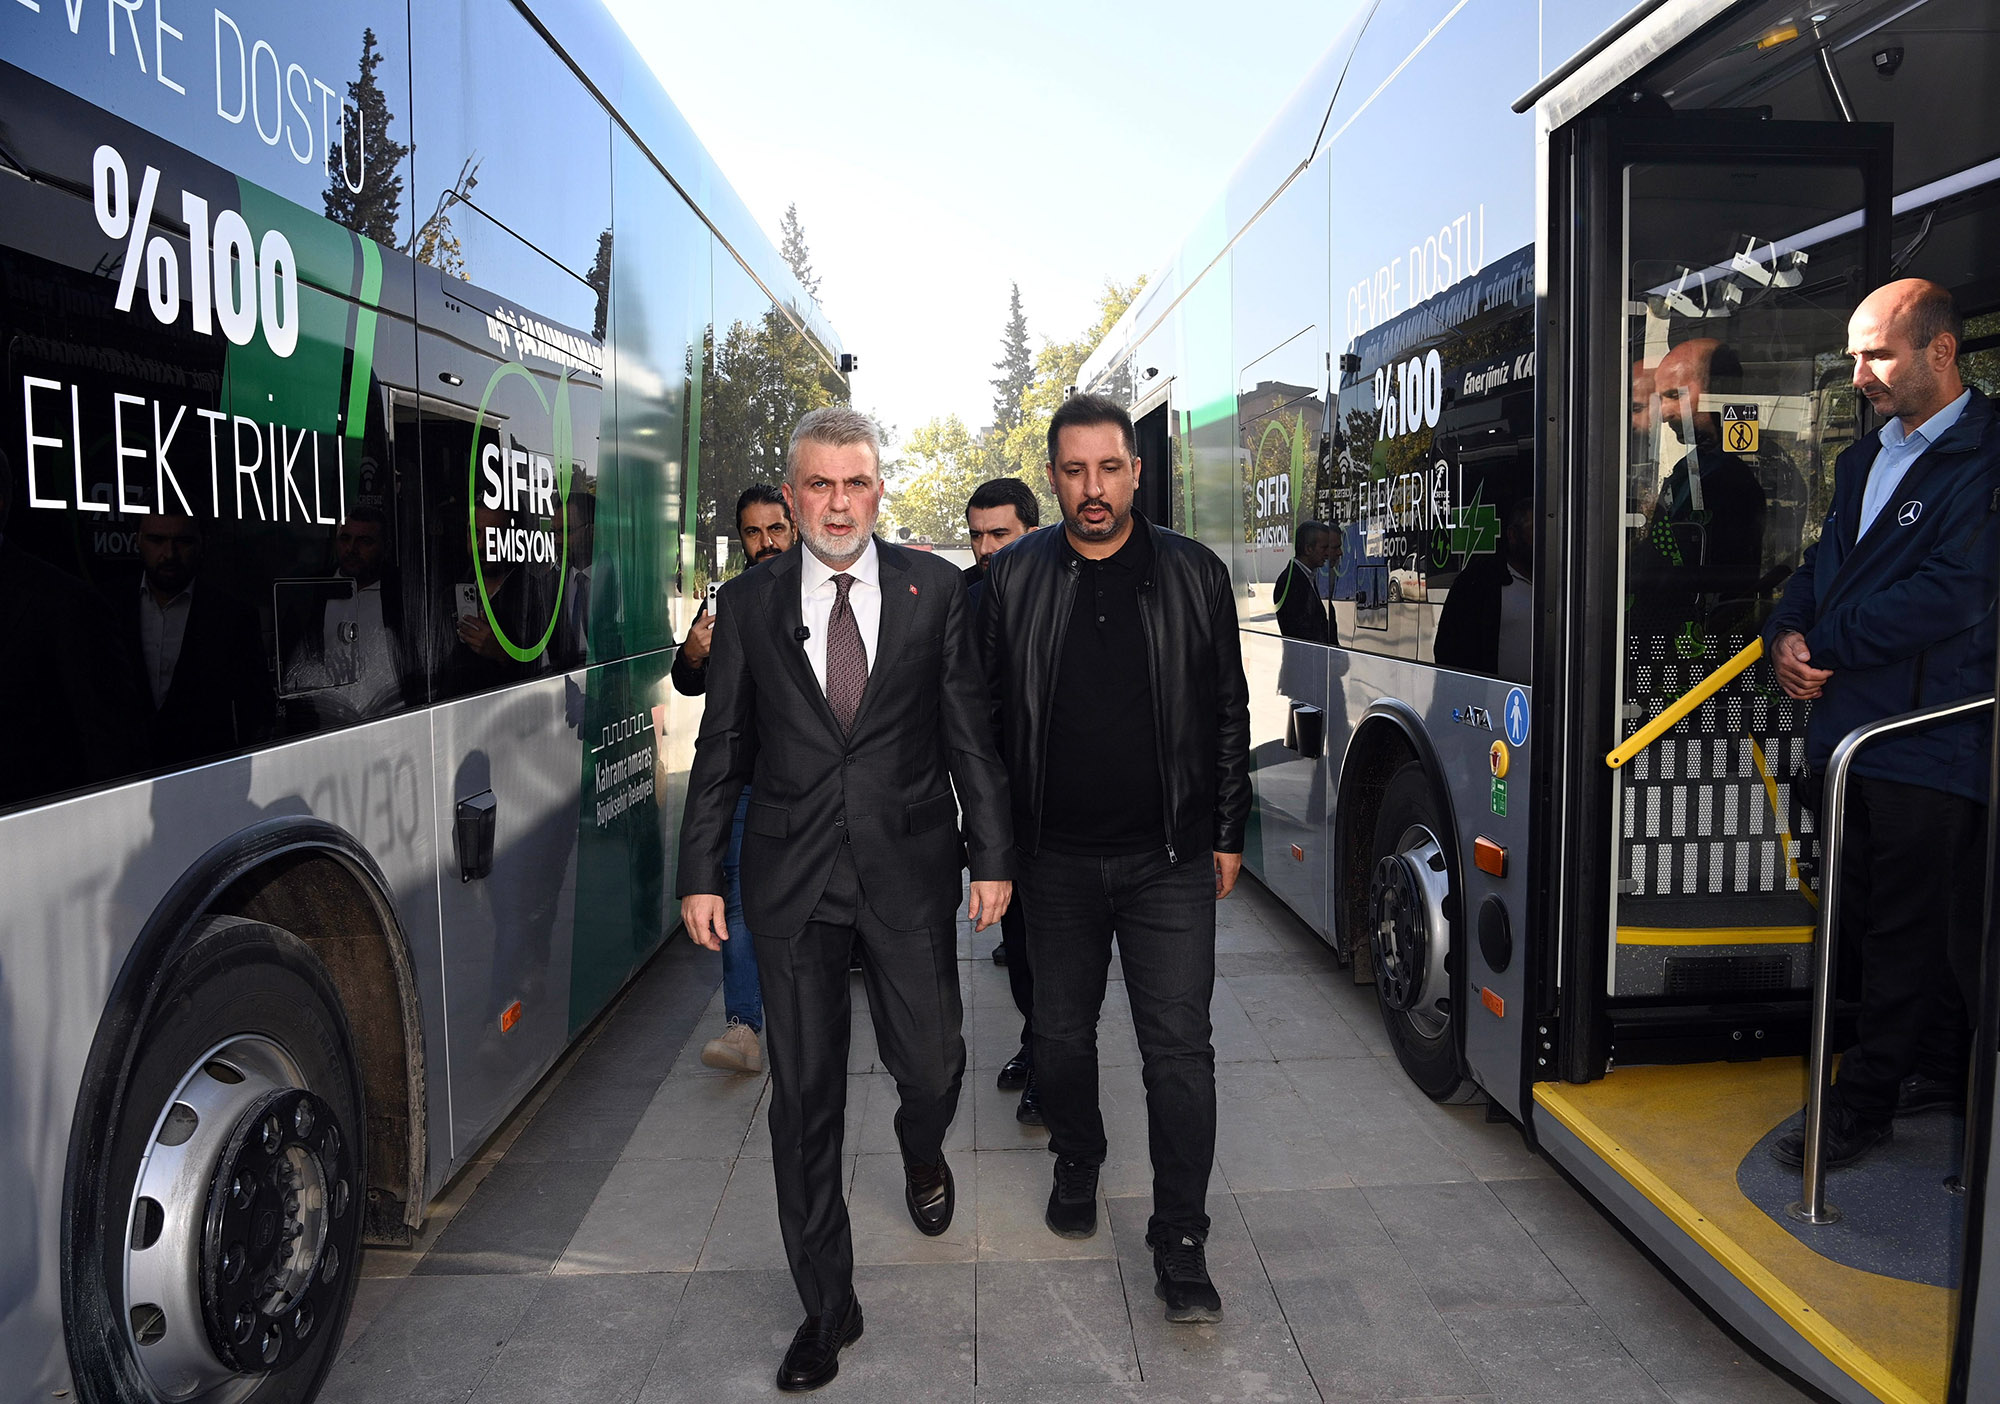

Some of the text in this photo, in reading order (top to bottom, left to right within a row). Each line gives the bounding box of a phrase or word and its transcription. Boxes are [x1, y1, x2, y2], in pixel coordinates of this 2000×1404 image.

[214, 8, 365, 195] DOSTU
[93, 144, 299, 358] %100
[1347, 203, 1484, 353] ÇEVRE DOSTU
[1374, 348, 1442, 441] %100
[1513, 351, 1535, 381] KA
[23, 375, 347, 526] ELEKTRİKLİ
[482, 443, 555, 516] SIFIR
[1359, 445, 1463, 536] ELEKTRİKLİ
[1256, 473, 1289, 519] SIFIR
[1256, 520, 1289, 549] EMİSYON
[485, 518, 556, 563] EMİSYON
[594, 745, 653, 794] Kahramanmaraş
